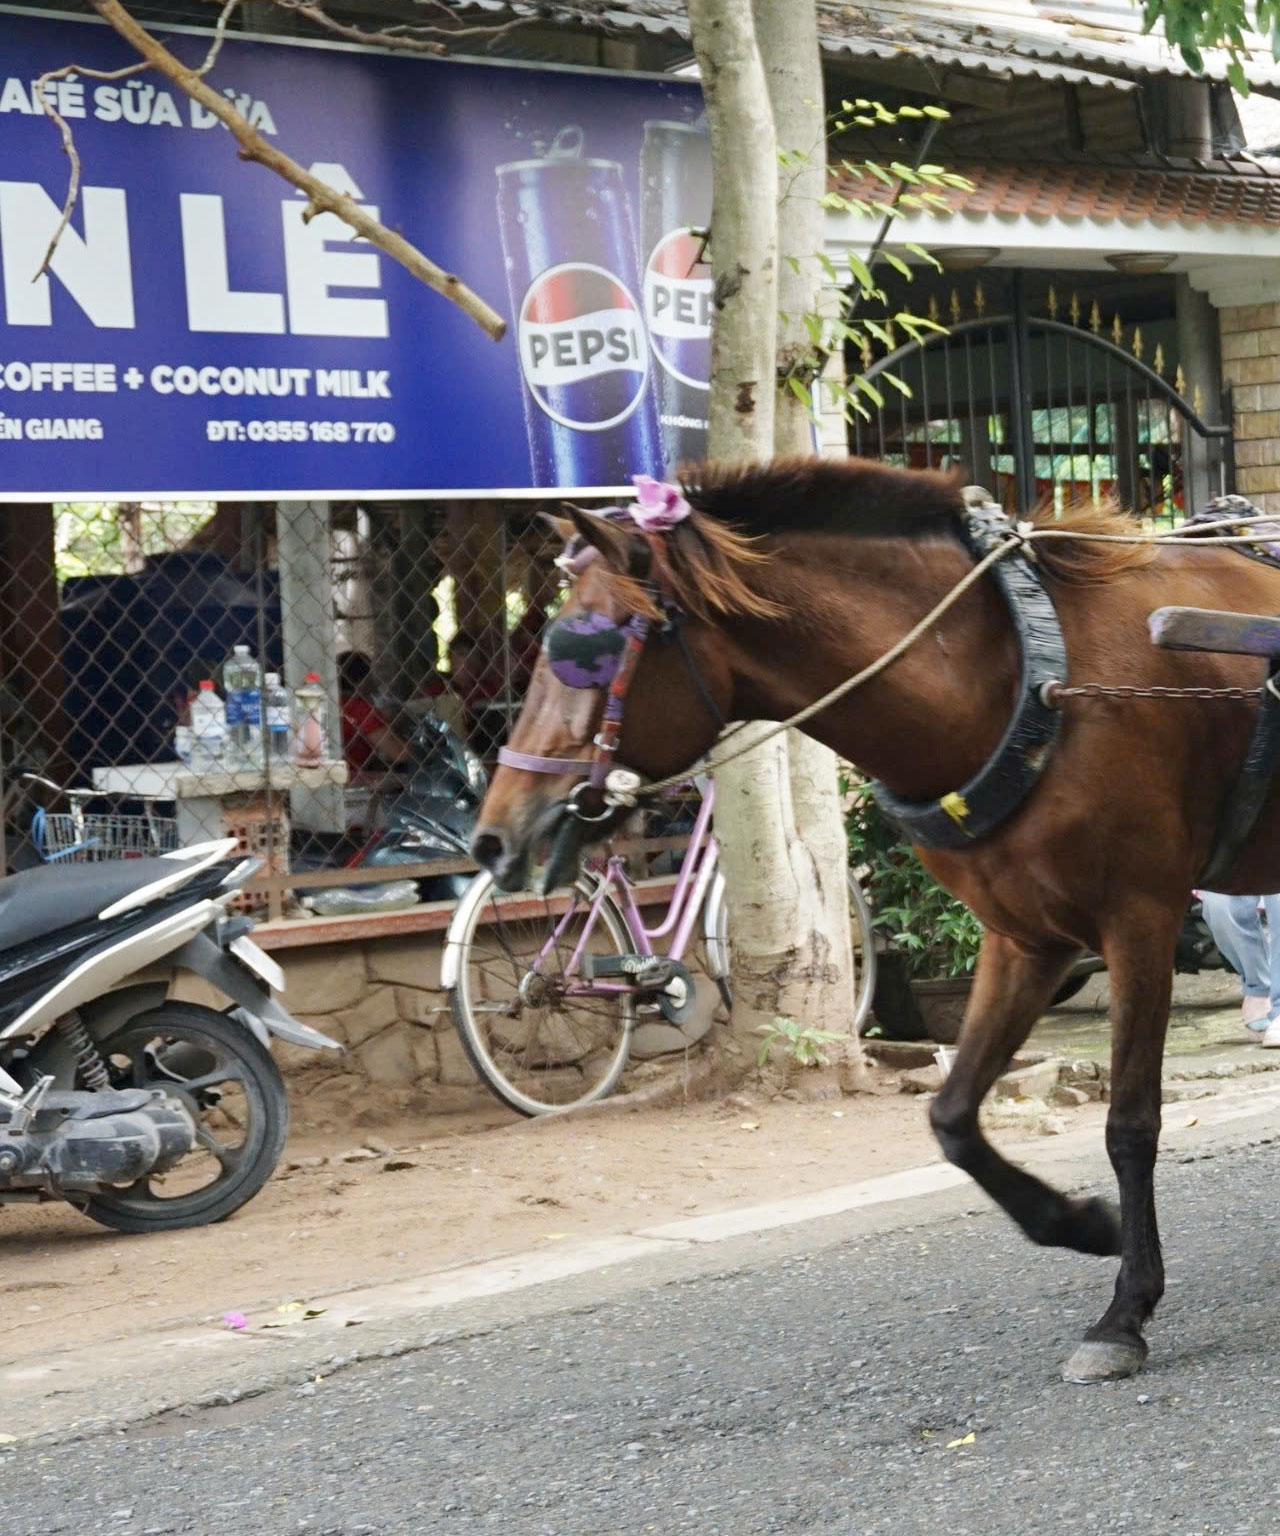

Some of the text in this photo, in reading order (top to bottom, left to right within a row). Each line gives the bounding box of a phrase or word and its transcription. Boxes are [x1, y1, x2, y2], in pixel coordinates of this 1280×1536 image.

[93, 80, 183, 128] SỮA
[179, 161, 390, 338] LÊ
[528, 326, 639, 369] PEPSI
[0, 361, 118, 392] OFFEE
[150, 364, 312, 397] COCONUT
[315, 368, 392, 398] MILK
[24, 418, 104, 440] GIANG
[309, 421, 350, 442] 168
[350, 422, 395, 443] 770
